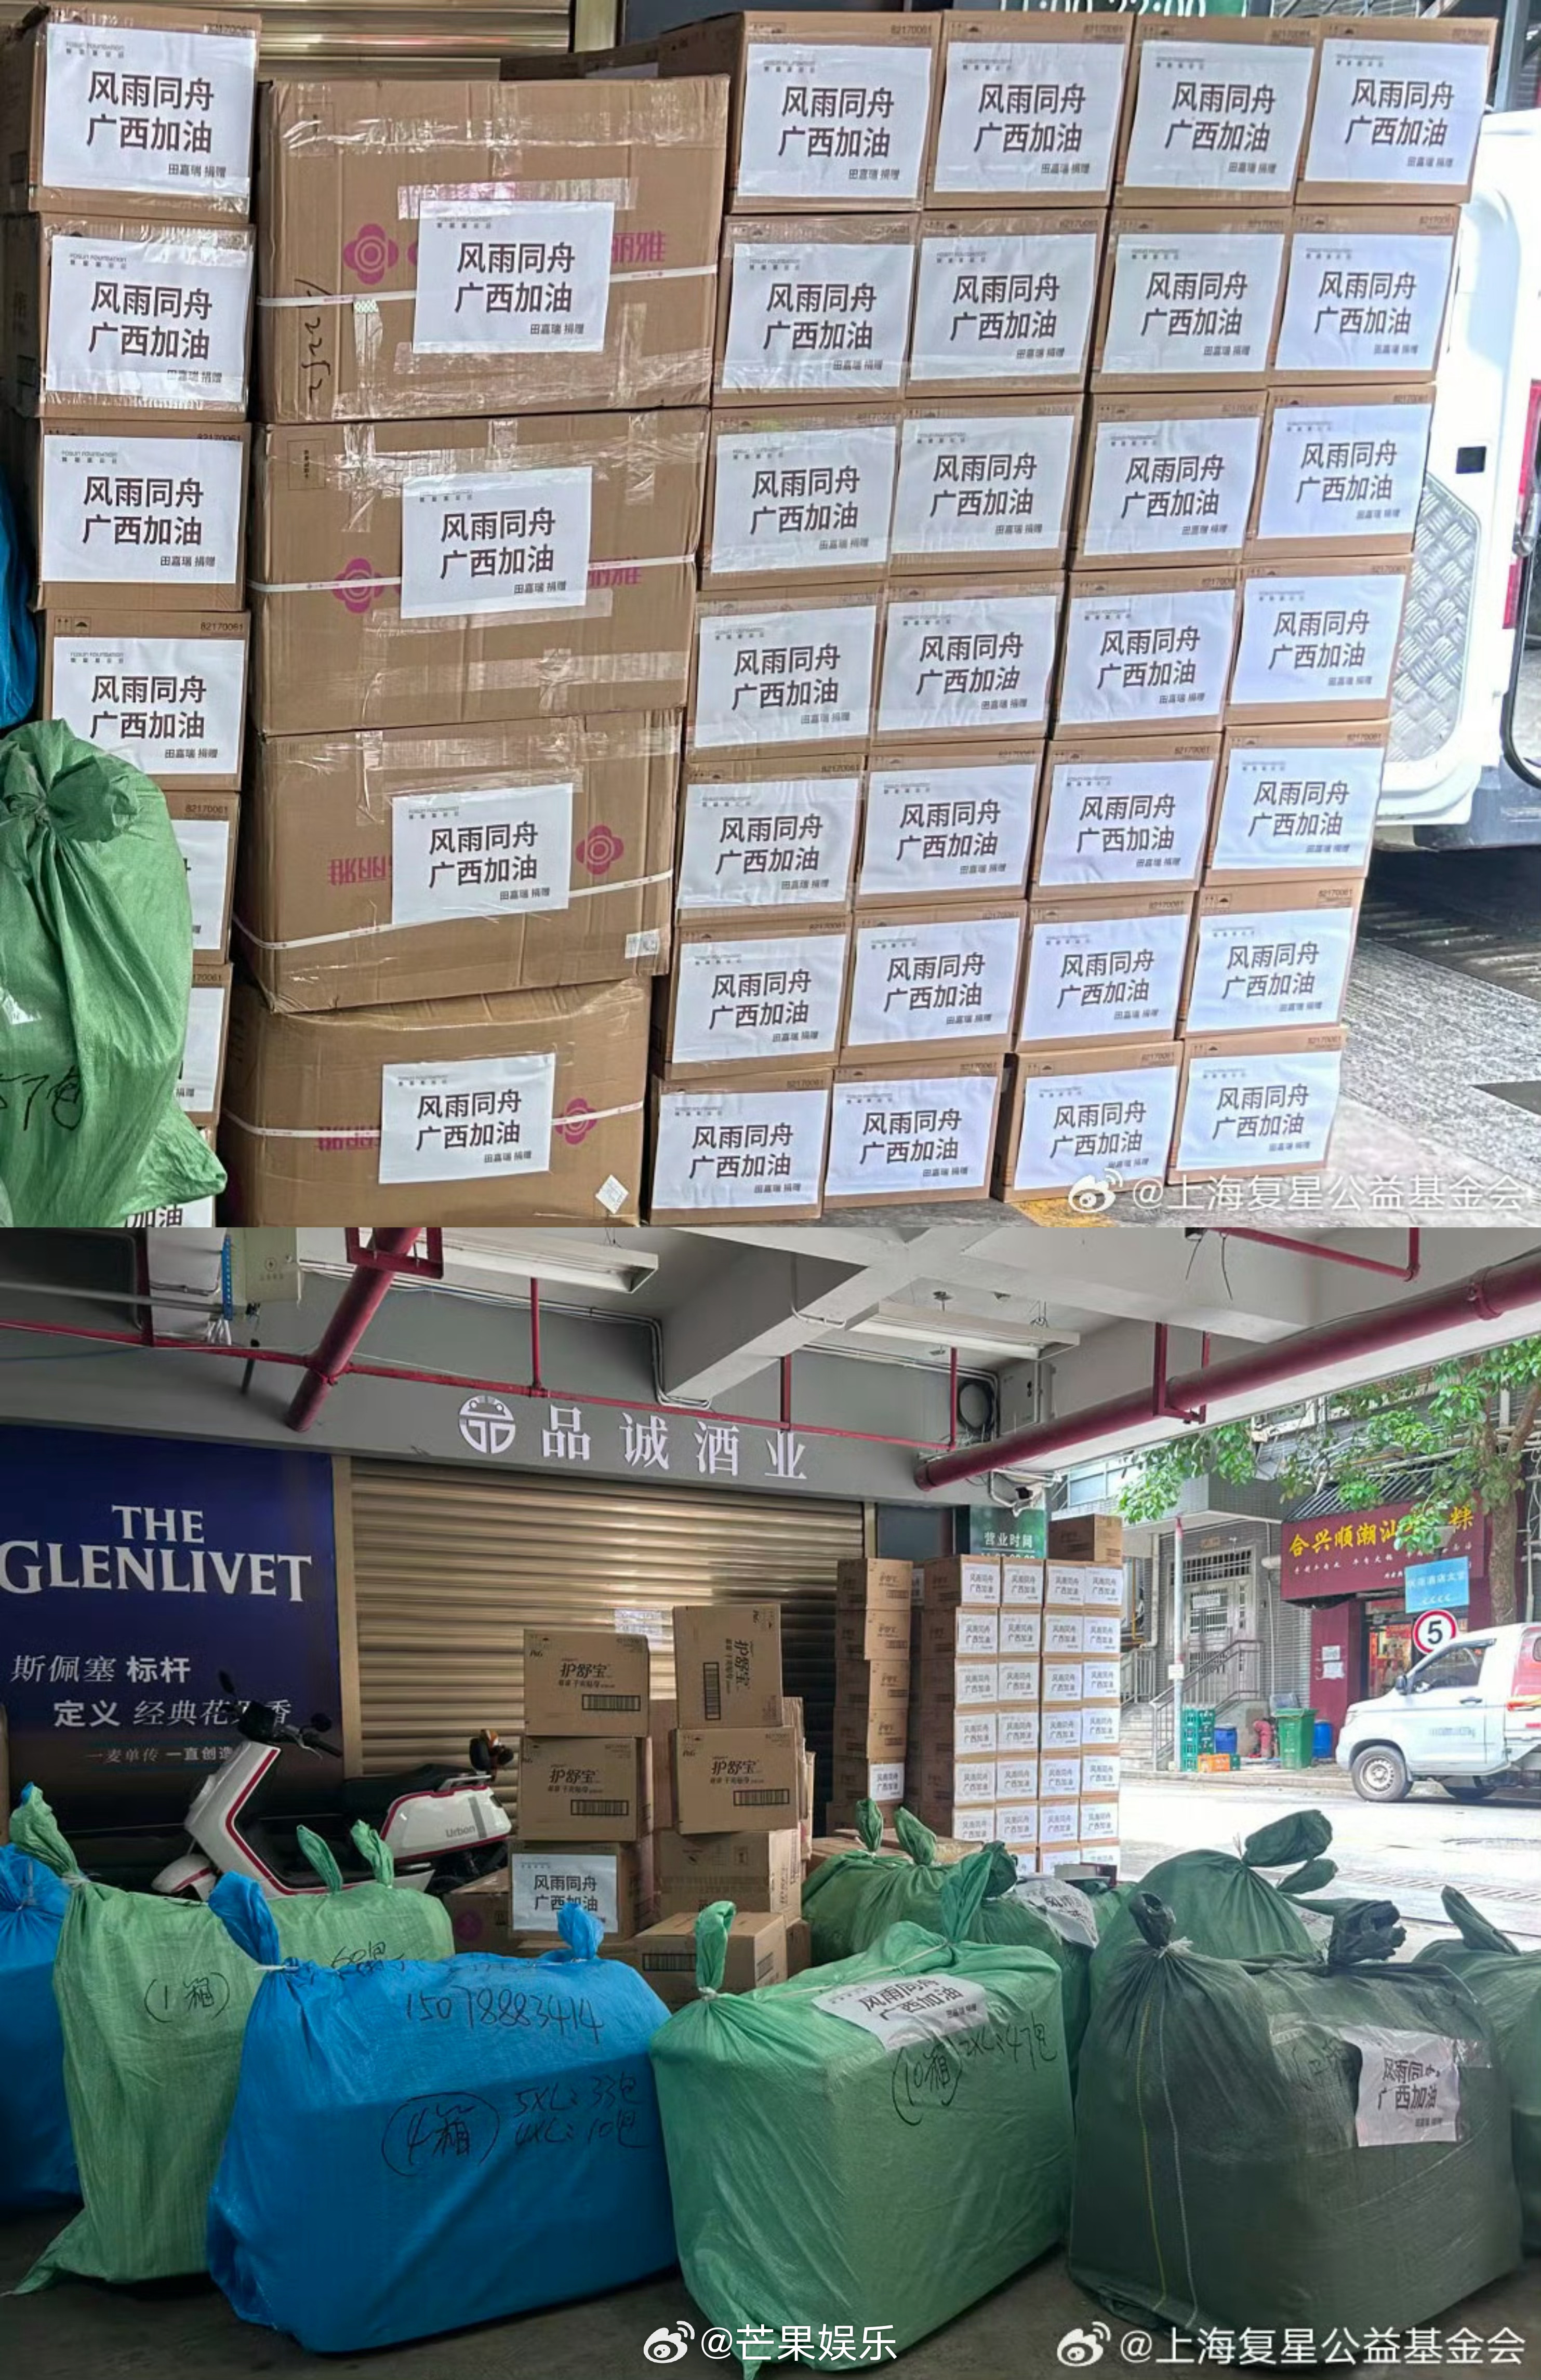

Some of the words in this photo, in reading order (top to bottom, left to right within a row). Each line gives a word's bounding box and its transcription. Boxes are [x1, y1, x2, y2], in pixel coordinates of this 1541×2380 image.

[87, 72, 215, 113] 风雨同舟
[780, 86, 895, 120] 风雨同舟
[977, 82, 1087, 116] 风雨同舟
[1171, 80, 1277, 116] 风雨同舟
[1350, 77, 1455, 111] 风雨同舟
[85, 112, 213, 155] 广西加油
[777, 124, 892, 159] 广西加油
[973, 120, 1084, 154] 广西加油
[1164, 117, 1271, 153] 广西加油
[1344, 114, 1449, 148] 广西加油
[456, 240, 577, 275] 风雨同舟
[454, 279, 573, 314] 广西加油
[765, 281, 878, 314] 风雨同舟
[951, 271, 1061, 305] 风雨同舟
[1145, 270, 1248, 302] 风雨同舟
[1318, 270, 1417, 301] 风雨同舟
[90, 283, 214, 322] 风雨同舟
[762, 318, 874, 352] 广西加油
[949, 307, 1058, 342] 广西加油
[1140, 306, 1243, 338] 广西加油
[1313, 304, 1412, 336] 广西加油
[87, 320, 211, 362] 广西加油
[932, 450, 1039, 484] 风雨同舟
[1124, 453, 1226, 486] 风雨同舟
[1300, 439, 1398, 470] 风雨同舟
[82, 476, 205, 510] 风雨同舟
[750, 464, 861, 500] 风雨同舟
[1295, 472, 1393, 504] 广西加油
[749, 500, 859, 536] 广西加油
[928, 486, 1034, 518] 广西加油
[1120, 487, 1220, 520] 广西加油
[82, 512, 203, 547] 广西加油
[440, 505, 557, 544] 风雨同舟
[160, 555, 192, 567] 田嘉瑞
[194, 555, 216, 567] 捐赠
[439, 542, 555, 581] 广西加油
[1272, 608, 1371, 638] 风雨同舟
[918, 630, 1025, 663] 风雨同舟
[1099, 624, 1201, 658] 风雨同舟
[1268, 640, 1366, 671] 广西加油
[733, 641, 842, 678] 风雨同舟
[1096, 657, 1197, 690] 广西加油
[90, 674, 208, 705] 风雨同舟
[730, 676, 840, 712] 广西加油
[915, 664, 1021, 697] 广西加油
[88, 709, 206, 740] 广西加油
[164, 748, 196, 759] 田嘉瑞
[197, 748, 218, 759] 捐赠
[1078, 793, 1176, 822] 风雨同舟
[1252, 779, 1350, 807] 风雨同舟
[718, 812, 825, 845] 风雨同舟
[898, 797, 1002, 830] 风雨同舟
[1247, 810, 1344, 838] 广西加油
[428, 820, 540, 857] 风雨同舟
[895, 830, 999, 862] 广西加油
[1075, 824, 1175, 854] 广西加油
[428, 852, 538, 890] 广西加油
[714, 844, 821, 876] 广西加油
[886, 951, 986, 983] 风雨同舟
[1059, 947, 1155, 980] 风雨同舟
[1226, 940, 1320, 971] 风雨同舟
[710, 968, 813, 1000] 风雨同舟
[883, 981, 983, 1013] 广西加油
[1056, 977, 1150, 1010] 广西加油
[1221, 970, 1316, 1000] 广西加油
[708, 998, 810, 1031] 广西加油
[416, 1087, 523, 1121] 风雨同舟
[1215, 1082, 1310, 1112] 风雨同舟
[862, 1107, 963, 1137] 风雨同舟
[1052, 1099, 1147, 1130] 风雨同舟
[1211, 1111, 1305, 1141] 广西加油
[415, 1118, 522, 1152] 广西加油
[691, 1121, 794, 1151] 风雨同舟
[858, 1135, 960, 1166] 广西加油
[1048, 1128, 1144, 1160] 广西加油
[688, 1151, 792, 1180] 广西加油
[542, 1404, 807, 1480] 品诚酒业
[111, 1504, 205, 1544] THE
[984, 1531, 1033, 1548] 营业时间
[0, 1540, 313, 1602] GLENLIVET
[1427, 1620, 1443, 1645] 5
[10, 1655, 117, 1683] 斯佩塞
[126, 1655, 191, 1683] 标杆
[560, 1662, 608, 1679] 护舒宝
[54, 1699, 121, 1727] 定义
[132, 1699, 293, 1727] 经典花香
[549, 1768, 596, 1784] 护舒宝
[711, 1759, 757, 1776] 护舒宝
[534, 1874, 597, 1892] 风雨同舟
